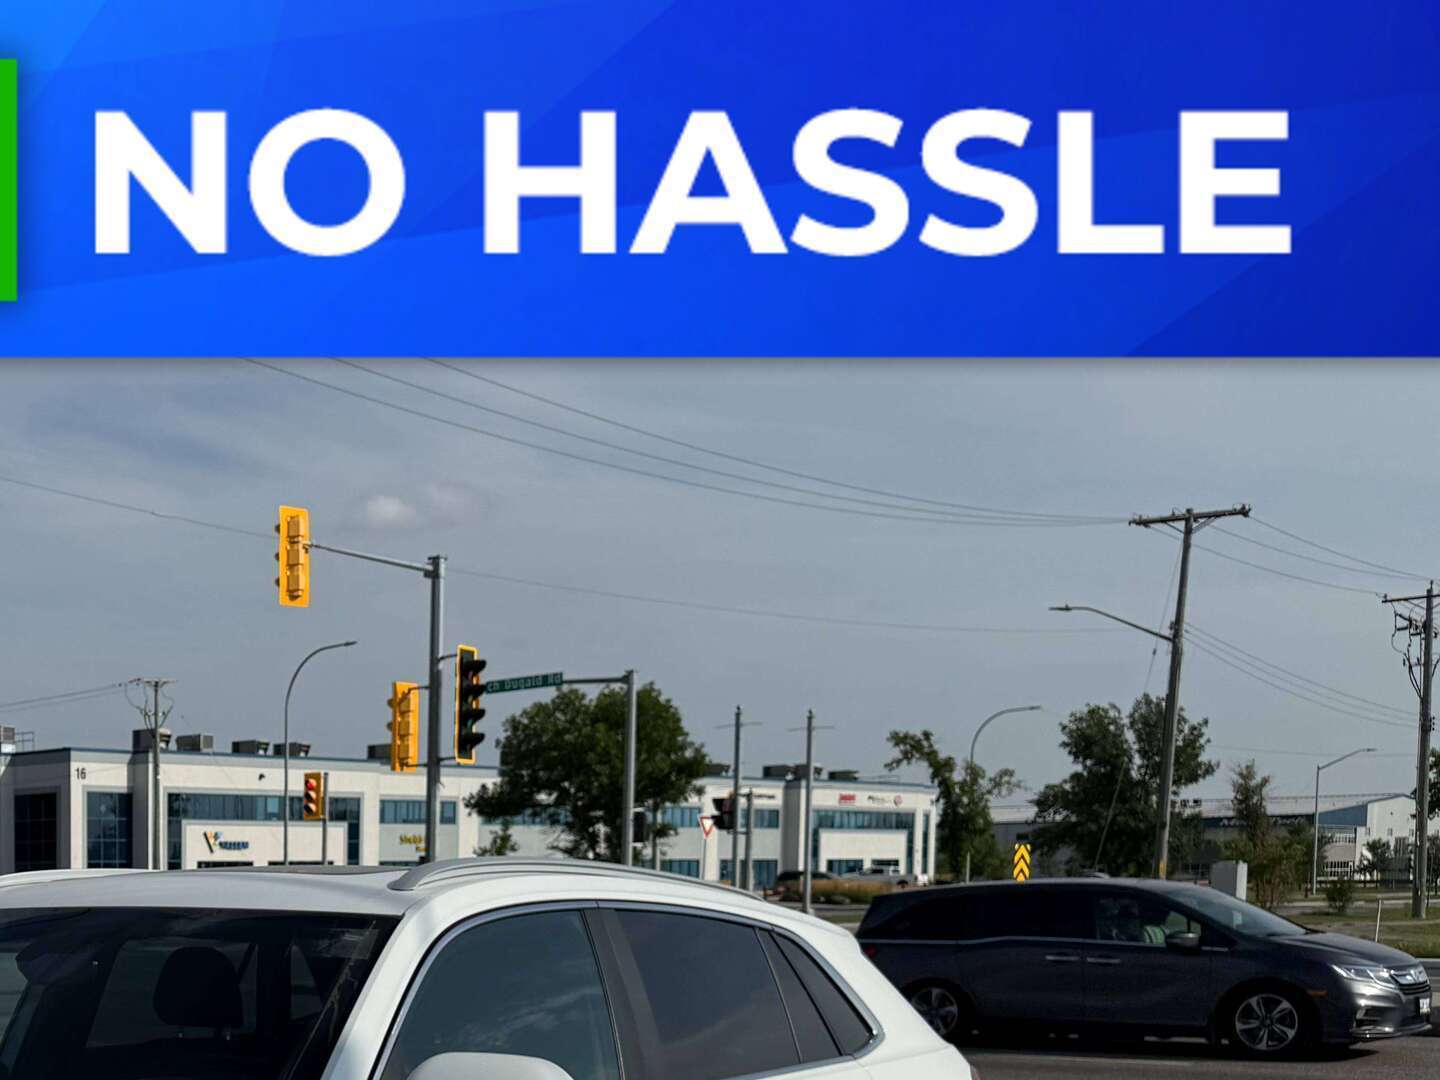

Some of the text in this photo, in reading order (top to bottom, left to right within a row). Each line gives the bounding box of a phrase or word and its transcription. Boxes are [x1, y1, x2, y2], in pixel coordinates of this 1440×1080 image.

[504, 676, 543, 690] Dugald
[547, 673, 561, 686] Rd
[75, 767, 87, 780] 16
